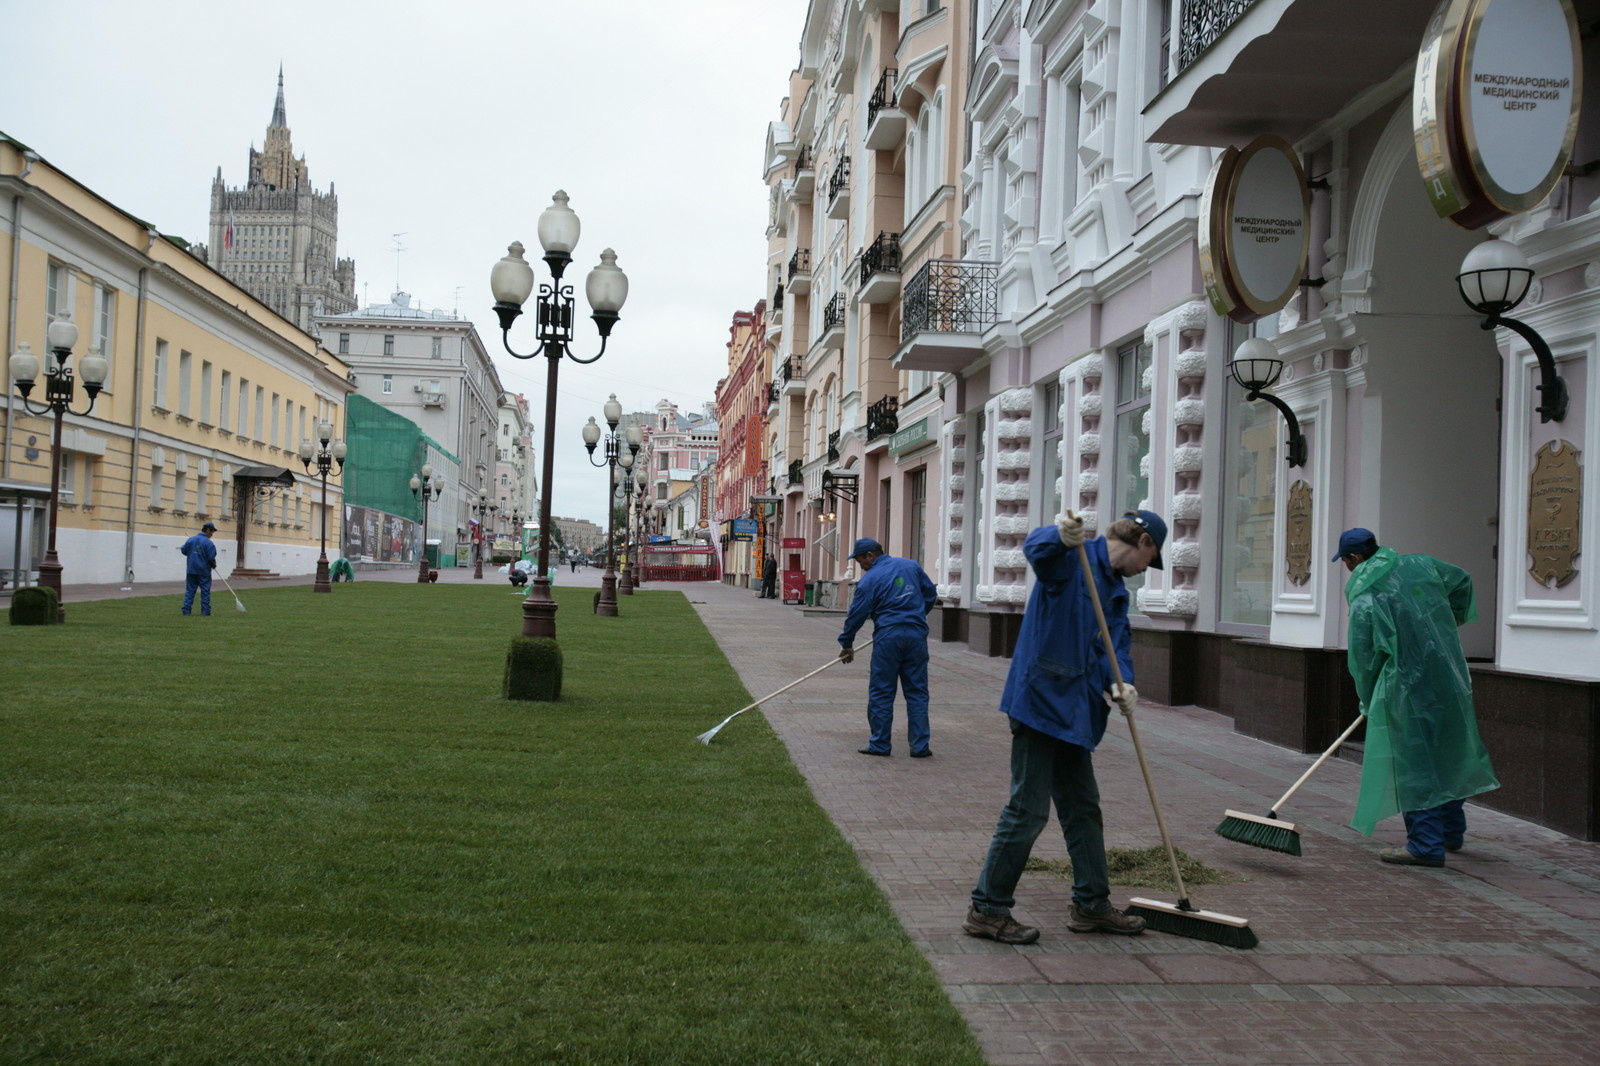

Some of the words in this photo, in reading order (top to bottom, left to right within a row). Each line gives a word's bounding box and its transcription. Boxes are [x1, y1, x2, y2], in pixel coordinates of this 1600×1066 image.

[1474, 73, 1570, 89] МЕЖДУНАРОДНЫЙ
[1482, 86, 1560, 100] МЕДИЦИНСКИЙ
[1503, 101, 1537, 111] ЦЕНТР
[1234, 216, 1302, 227] МЕЖДУНАРОДНЫЙ
[1240, 226, 1296, 236] МЕДИЦИНСКИЙ
[1255, 235, 1280, 243] ЦЕНТР
